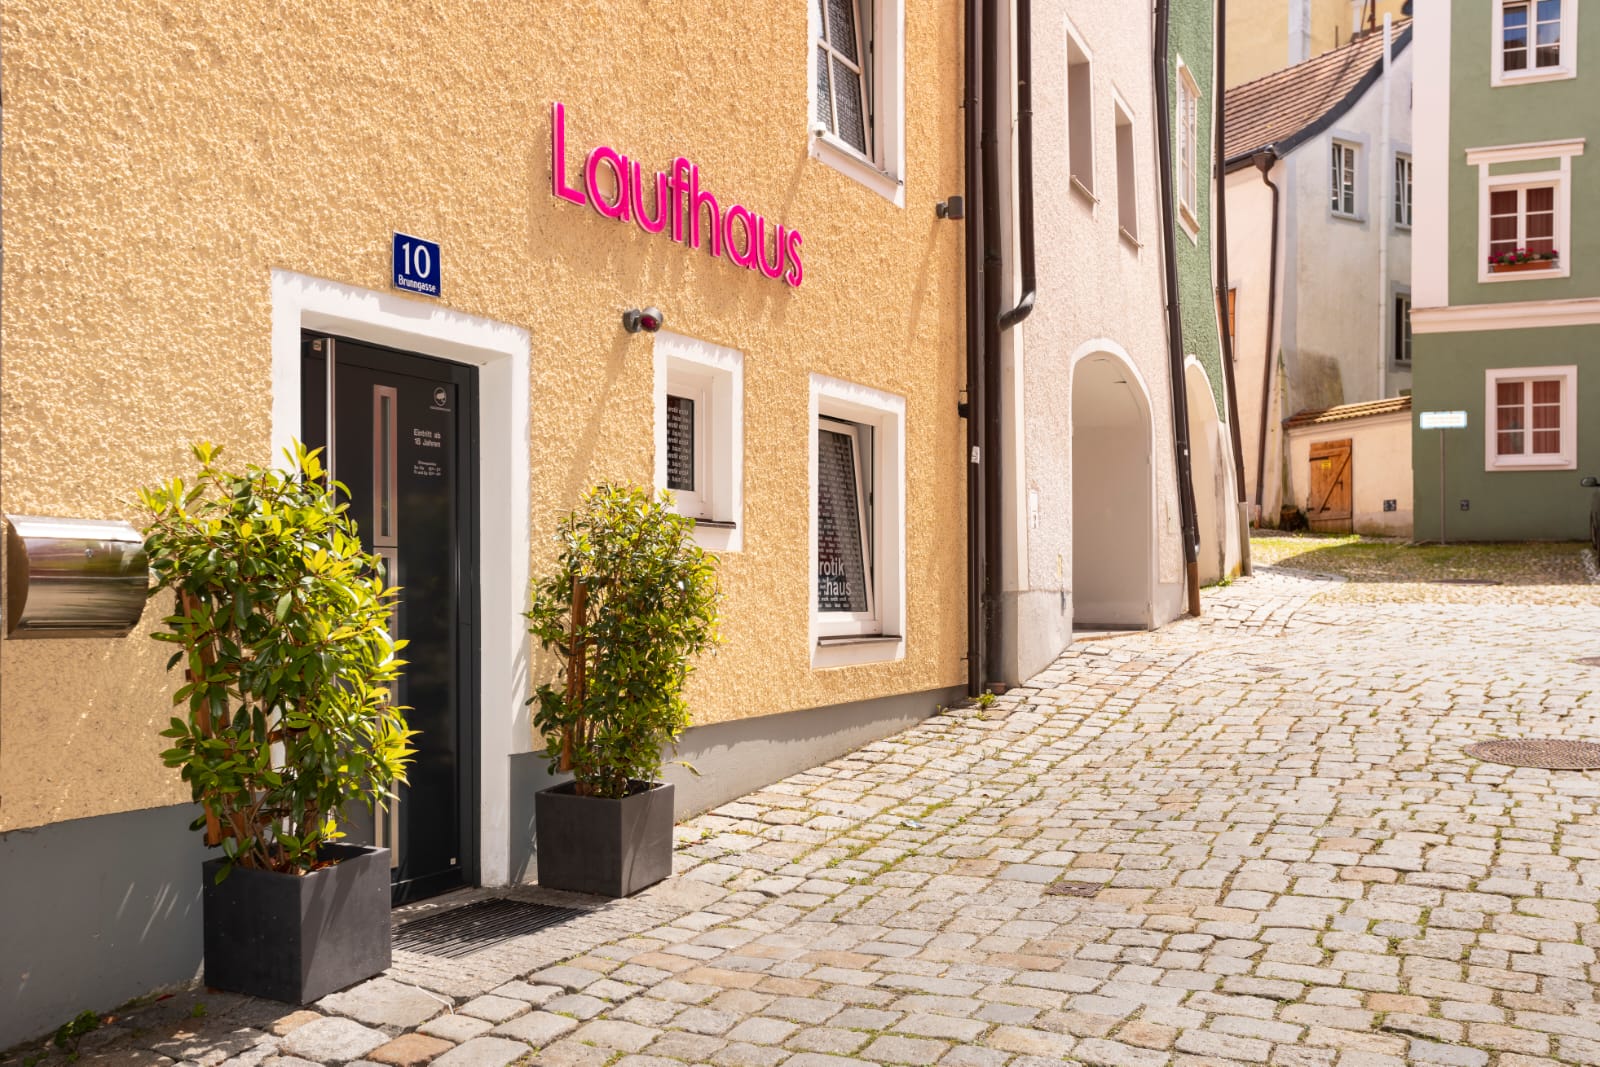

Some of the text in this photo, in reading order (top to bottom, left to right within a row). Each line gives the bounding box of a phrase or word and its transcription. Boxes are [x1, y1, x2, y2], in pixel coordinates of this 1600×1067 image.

[552, 101, 803, 287] Laufhaus
[402, 242, 431, 279] 10
[398, 273, 437, 293] Brunngasse
[819, 557, 845, 576] rotik
